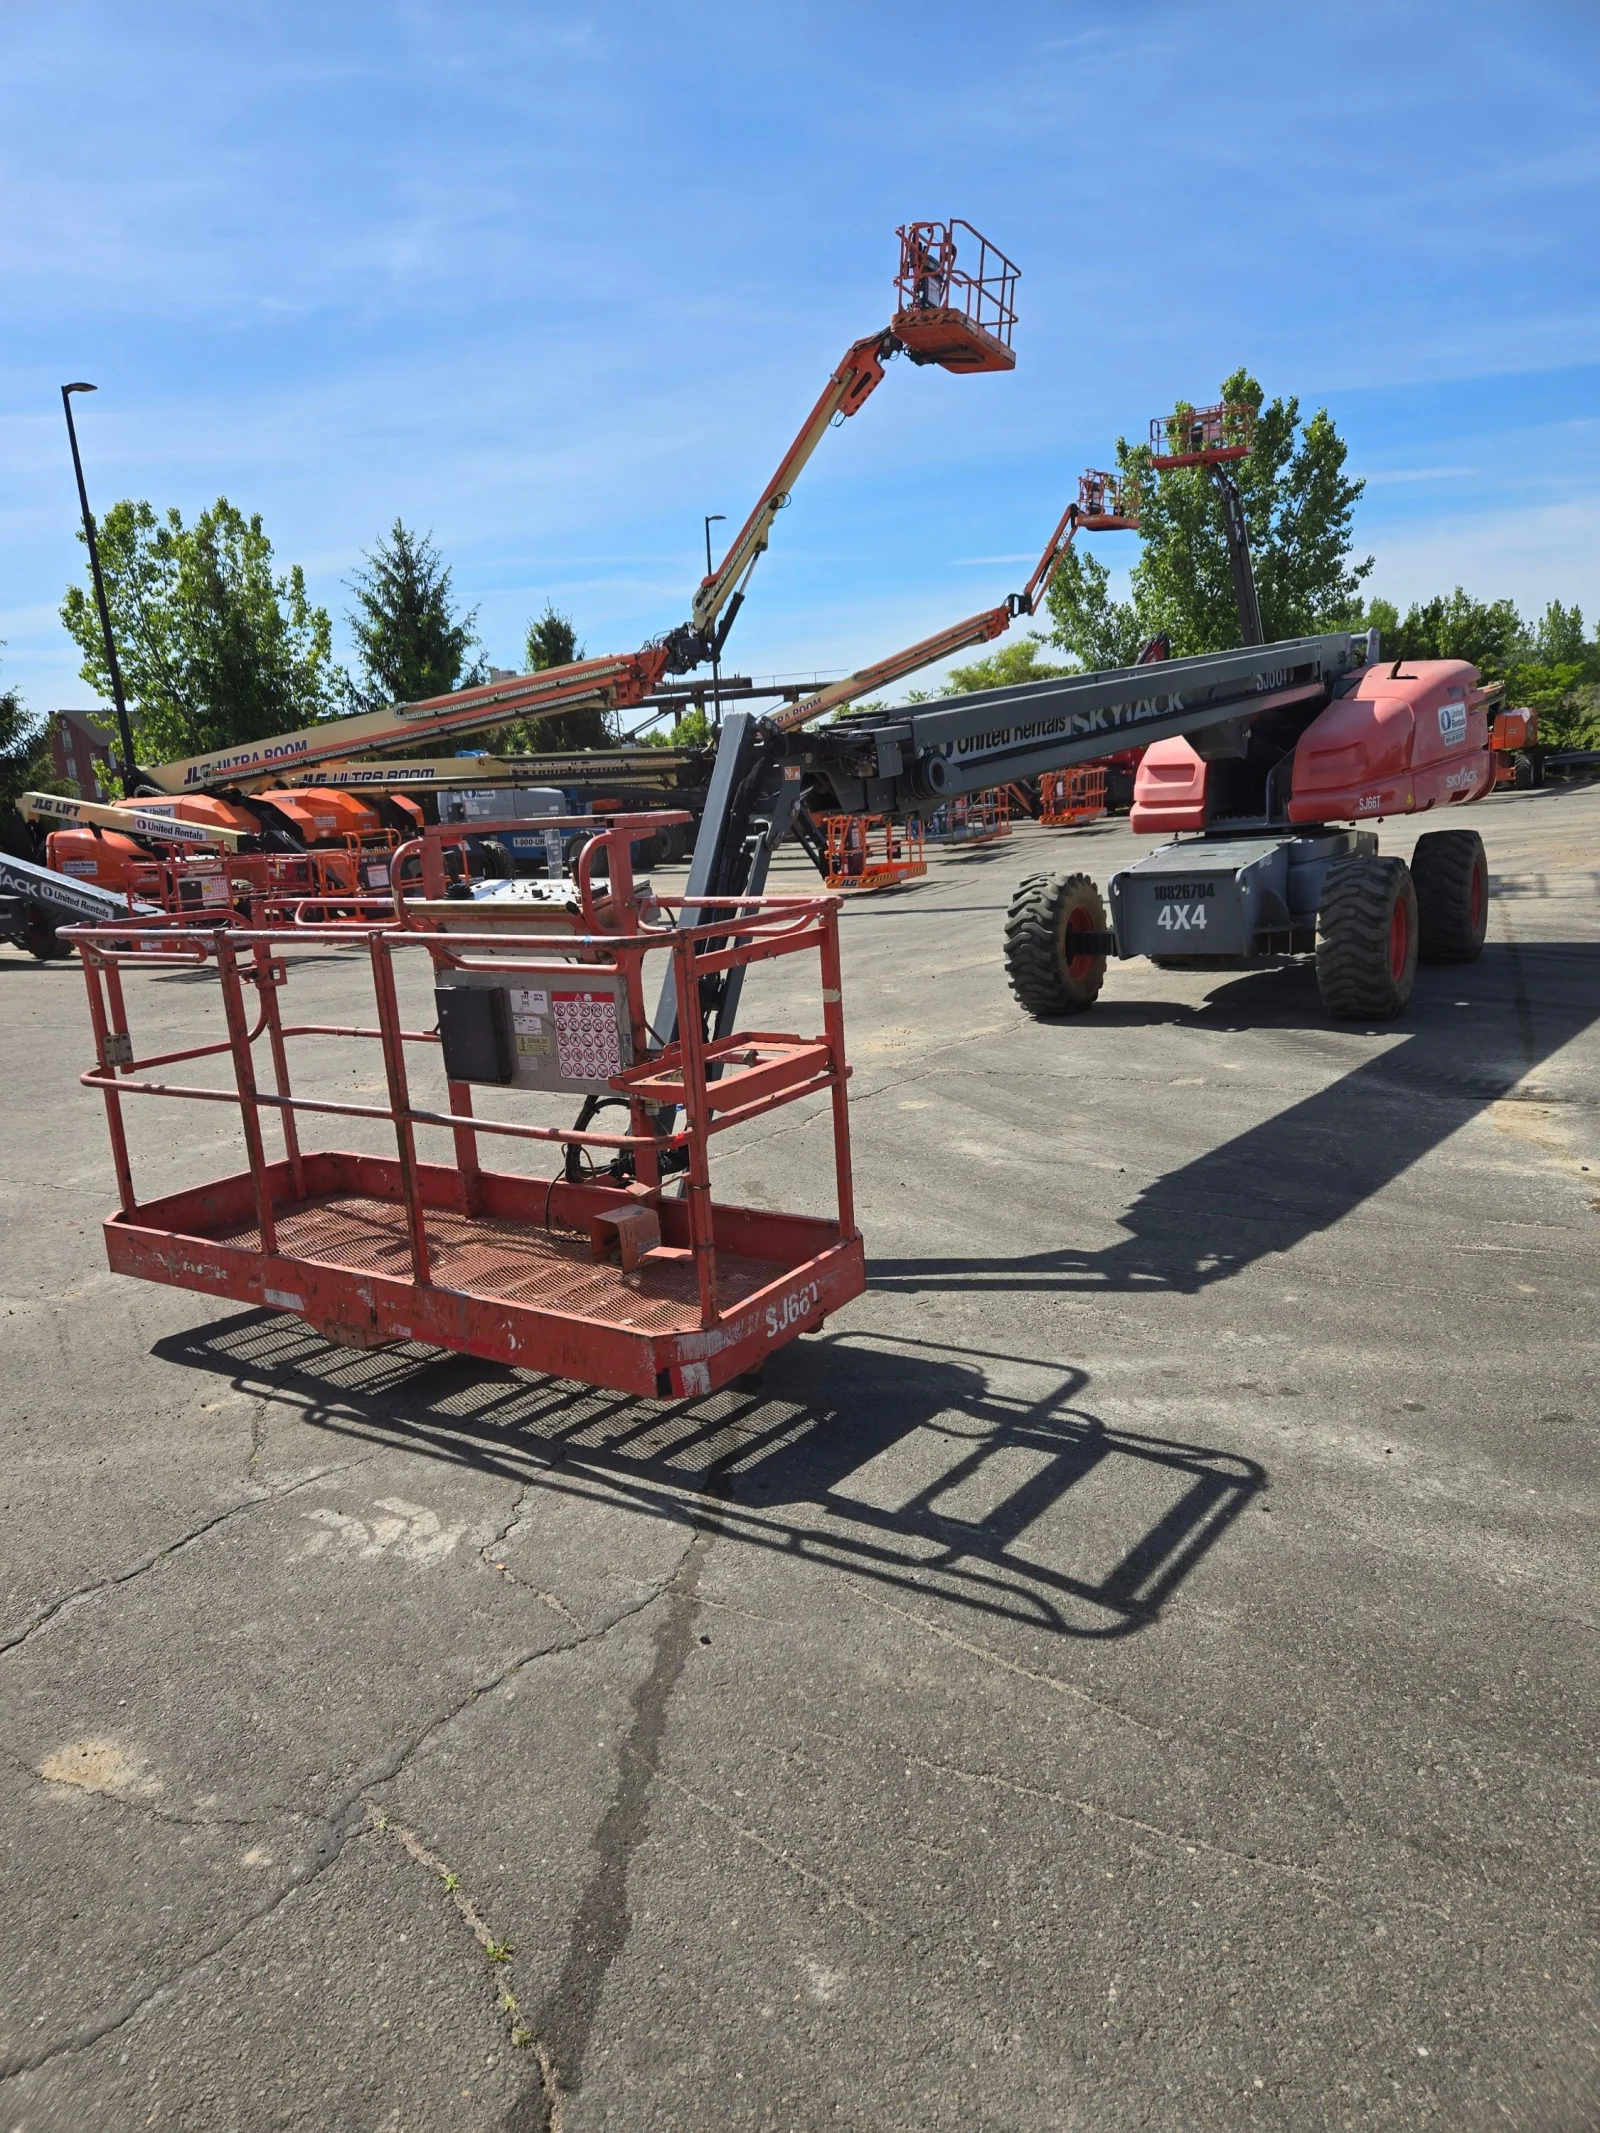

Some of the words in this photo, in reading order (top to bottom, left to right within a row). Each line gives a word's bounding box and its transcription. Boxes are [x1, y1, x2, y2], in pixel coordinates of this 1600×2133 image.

[264, 740, 308, 760] BOOM
[1446, 766, 1477, 788] SKYJACK
[32, 798, 53, 811] JLG
[55, 801, 81, 817] LIFT
[1358, 794, 1381, 811] SJ66T
[147, 822, 173, 835] United
[174, 827, 203, 841] Rentals
[840, 879, 858, 887] JLG
[1153, 883, 1216, 901] 10826704
[54, 890, 80, 907] United
[80, 900, 110, 918] Rentals
[1157, 904, 1207, 930] 4X4
